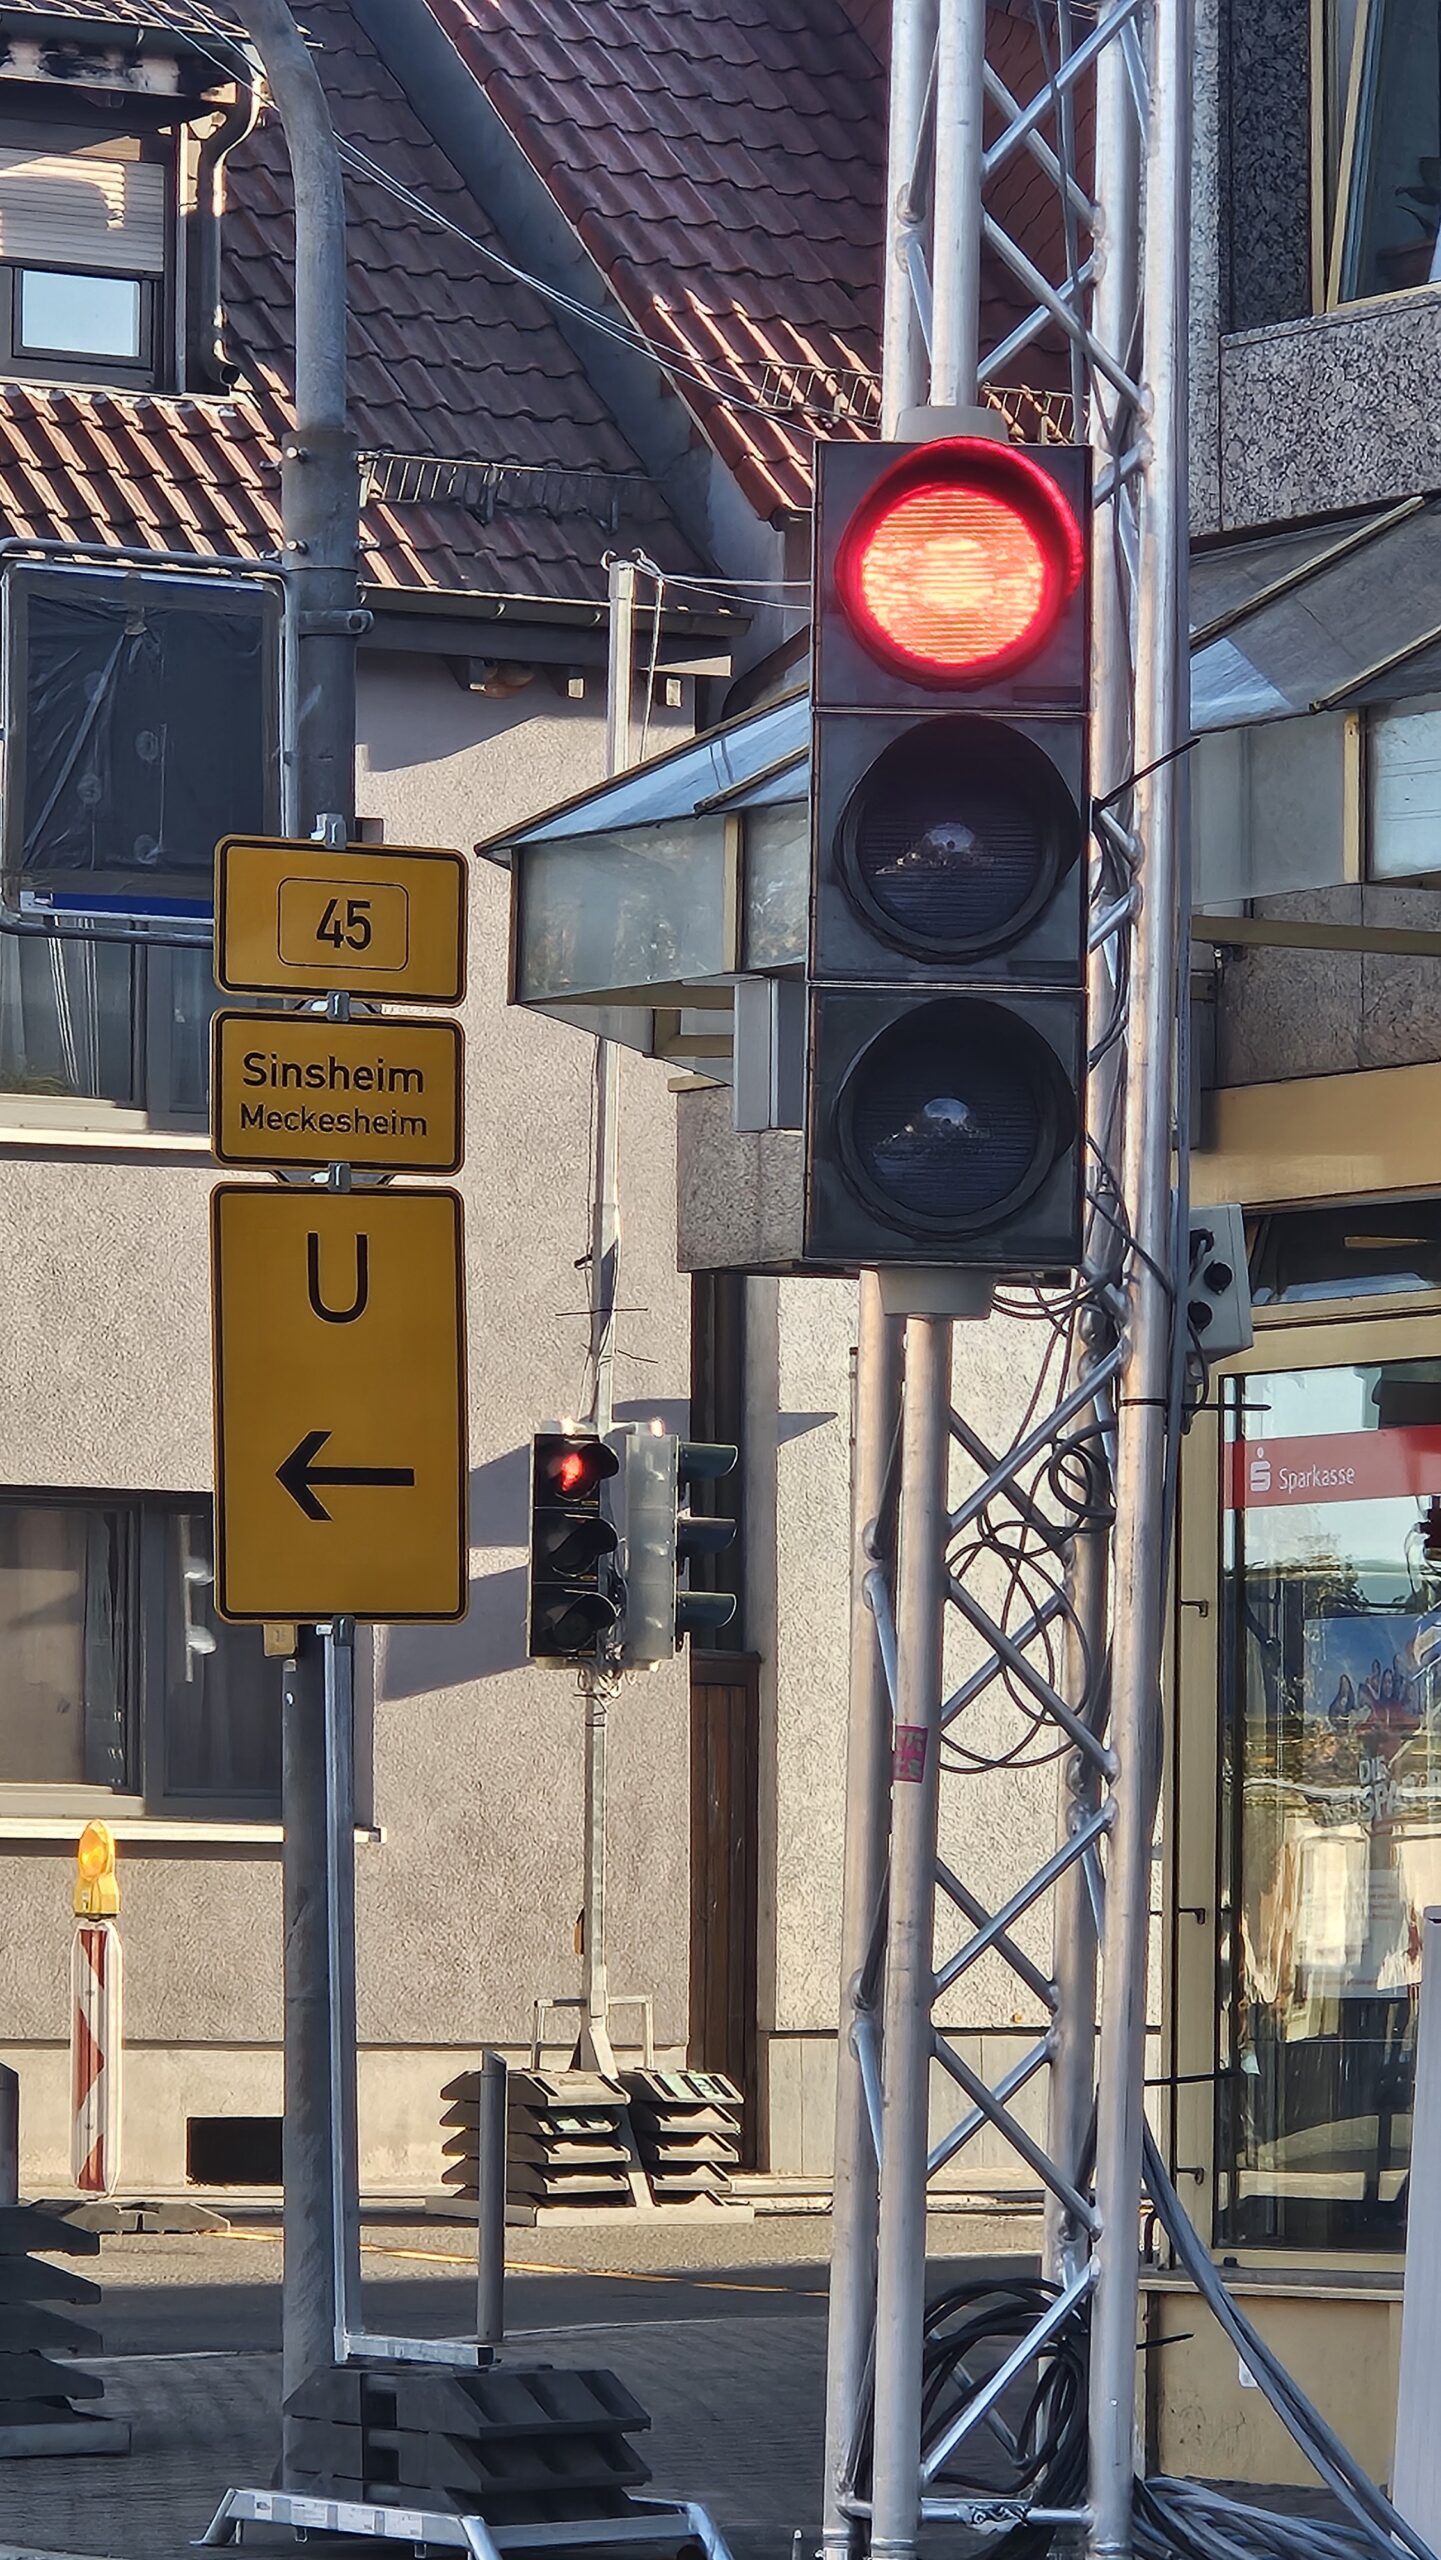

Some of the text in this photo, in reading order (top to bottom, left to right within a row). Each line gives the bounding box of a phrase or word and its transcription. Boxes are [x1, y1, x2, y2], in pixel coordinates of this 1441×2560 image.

[316, 898, 372, 950] 45
[243, 1051, 424, 1093] Sinsheim
[240, 1102, 427, 1136] Meckesheim
[307, 1232, 368, 1324] U
[1279, 1464, 1355, 1494] Sparkasse
